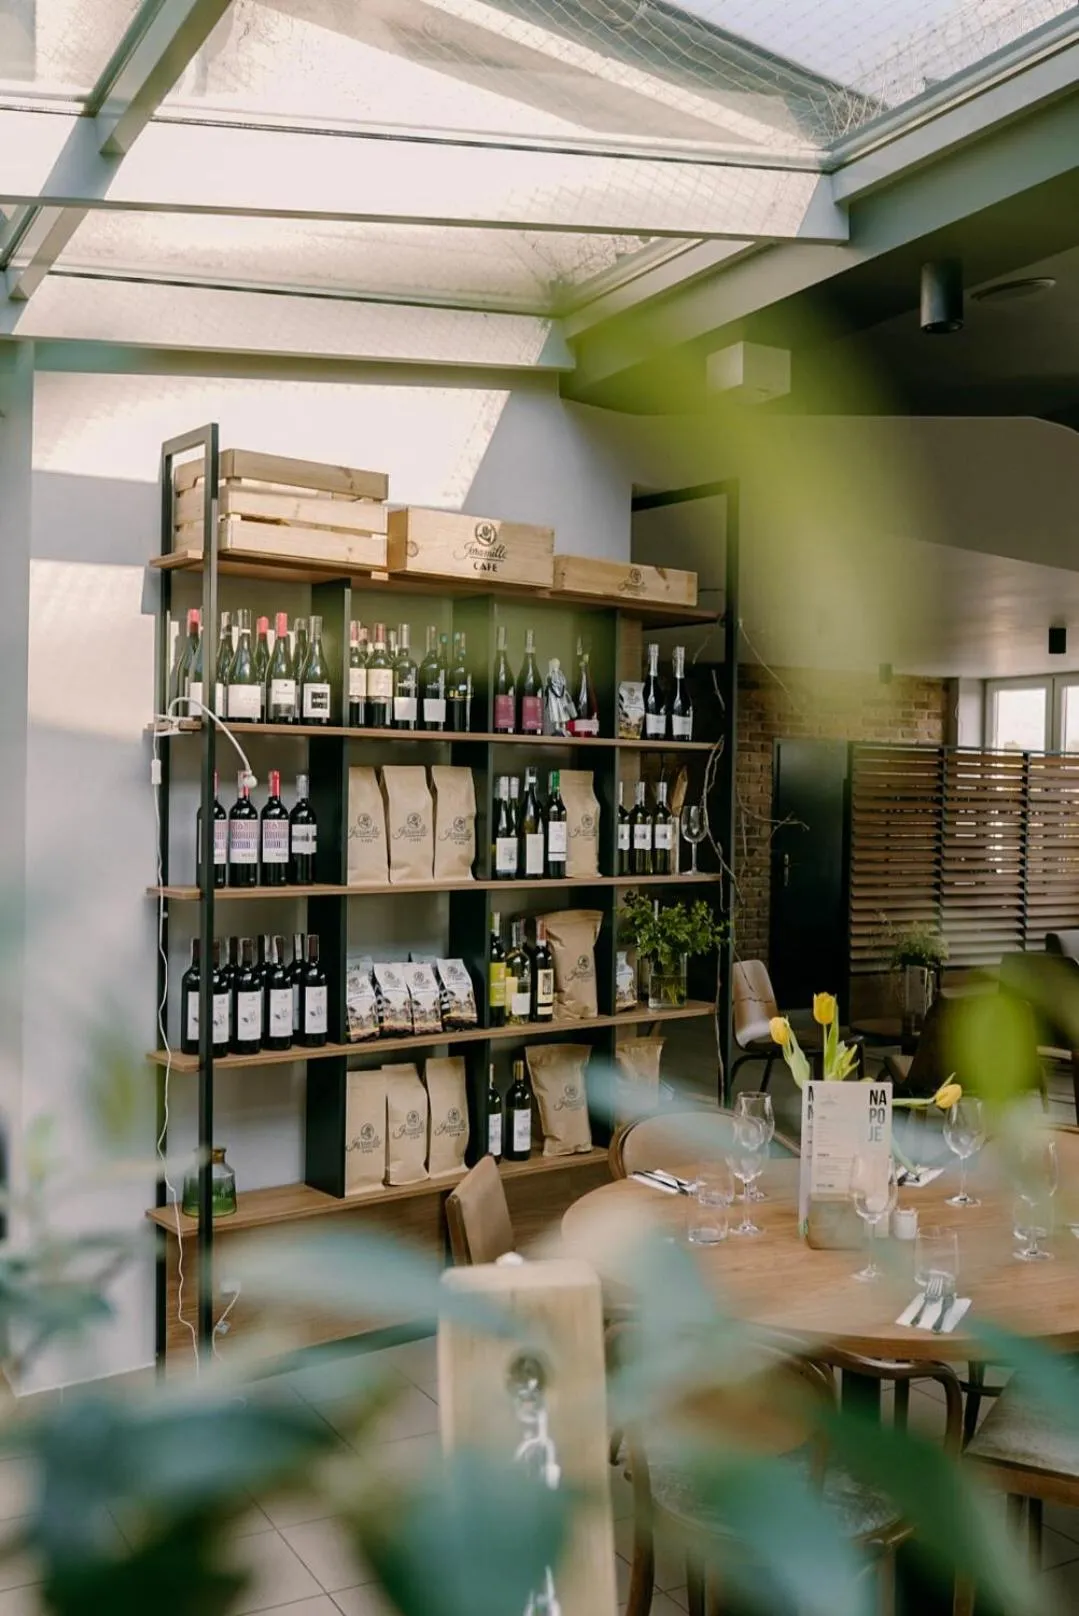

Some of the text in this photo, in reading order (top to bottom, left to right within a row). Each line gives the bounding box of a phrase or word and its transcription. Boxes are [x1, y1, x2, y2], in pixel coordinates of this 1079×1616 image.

[869, 1089, 887, 1106] NA
[868, 1107, 886, 1125] PO
[868, 1125, 882, 1142] JE
